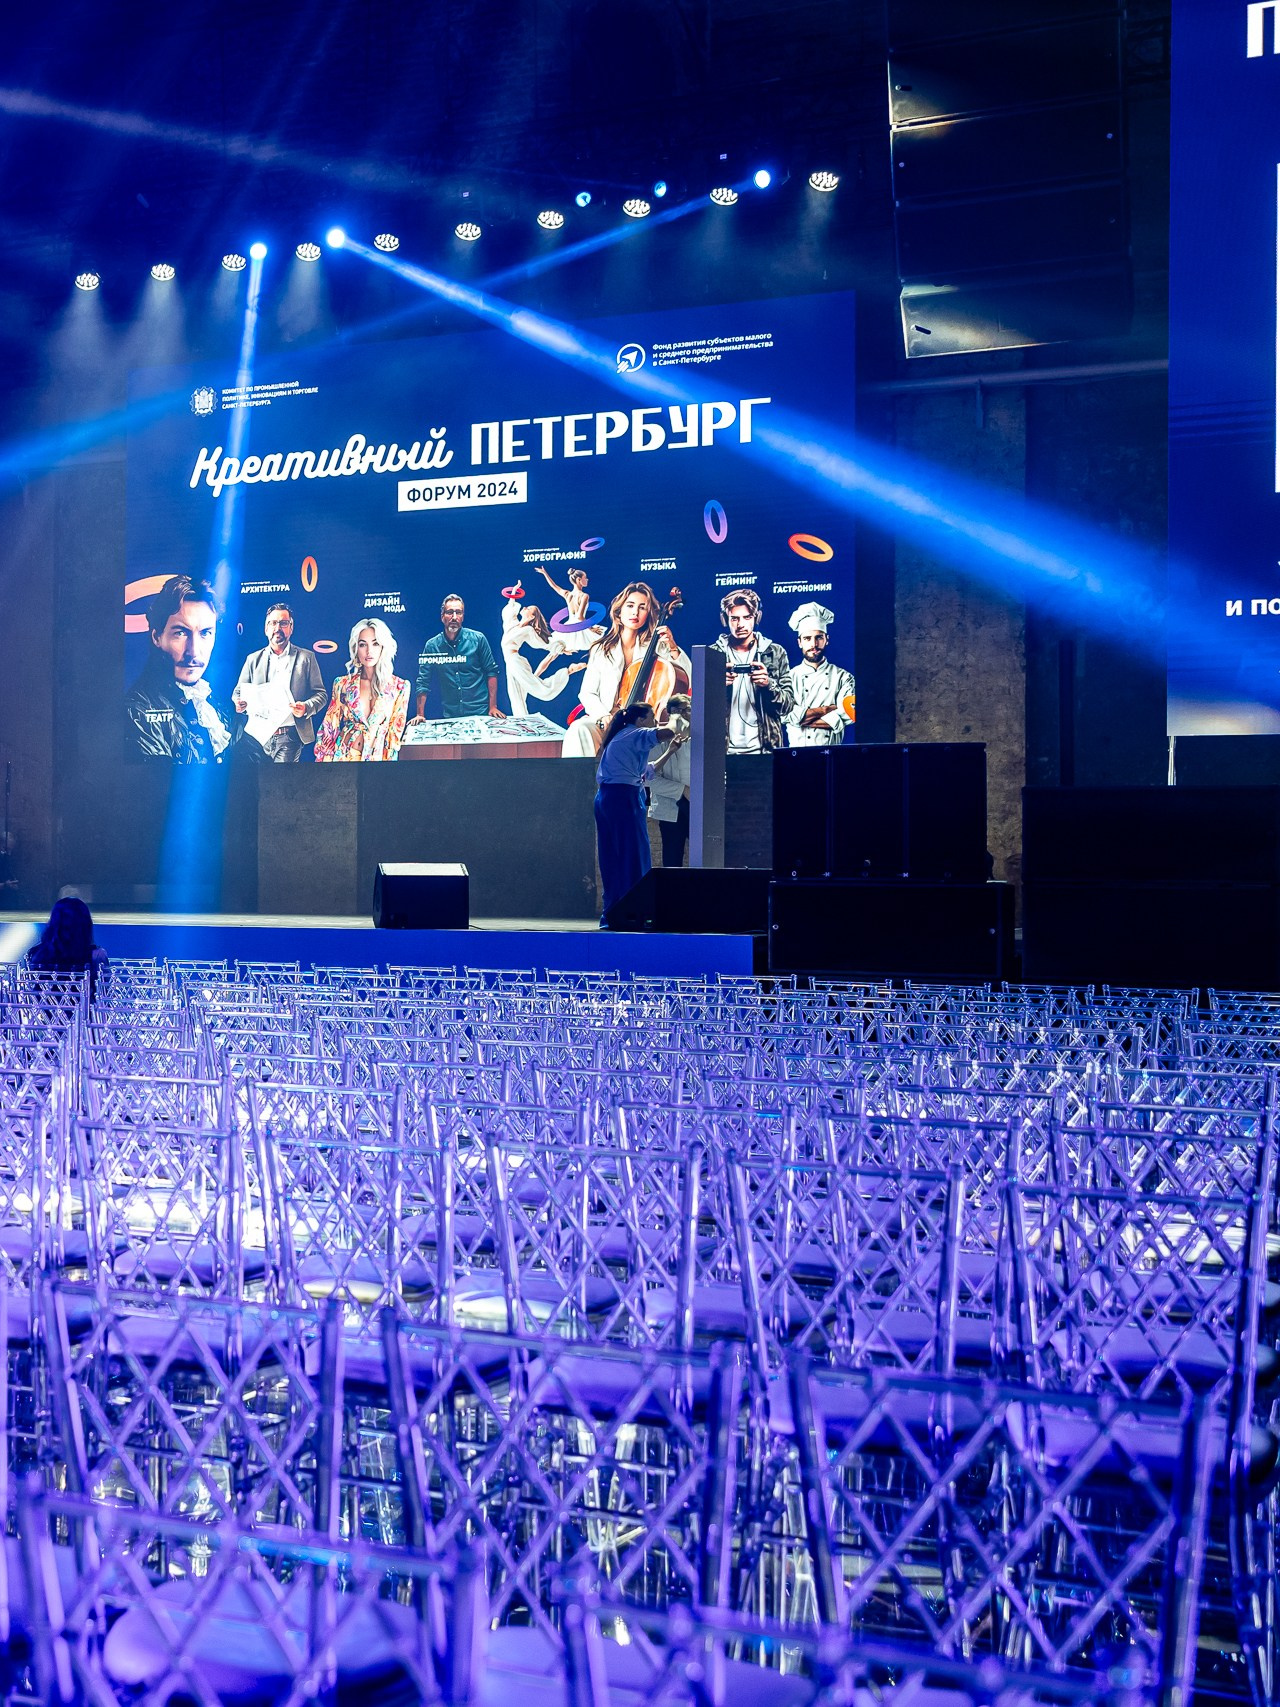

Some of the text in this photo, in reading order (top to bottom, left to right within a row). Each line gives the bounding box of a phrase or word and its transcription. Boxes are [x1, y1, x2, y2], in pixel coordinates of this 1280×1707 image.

[652, 333, 772, 351] Фонд развития субъектов малого
[659, 349, 691, 359] среднего
[692, 341, 773, 356] предпринимательства
[658, 354, 722, 367] Санкт-Петербурге
[190, 397, 771, 497] Креативный ПЕТЕРБУРГ
[407, 480, 518, 504] ФОРУМ 2024
[523, 550, 586, 563] ХОРЕОГРАФИЯ
[640, 561, 677, 571] МУЗЫКА
[715, 575, 758, 587] ГЕЙМИНГ
[240, 584, 290, 594] АРХИТЕКТУРА
[773, 582, 832, 594] ГАСТРОНОМИЯ
[363, 595, 400, 608] ДИЗАЙН
[1225, 599, 1243, 617] и
[383, 604, 406, 613] МОДА
[418, 654, 467, 665] ПРОМДИЗАЙН
[145, 712, 174, 723] ТЕАТР
